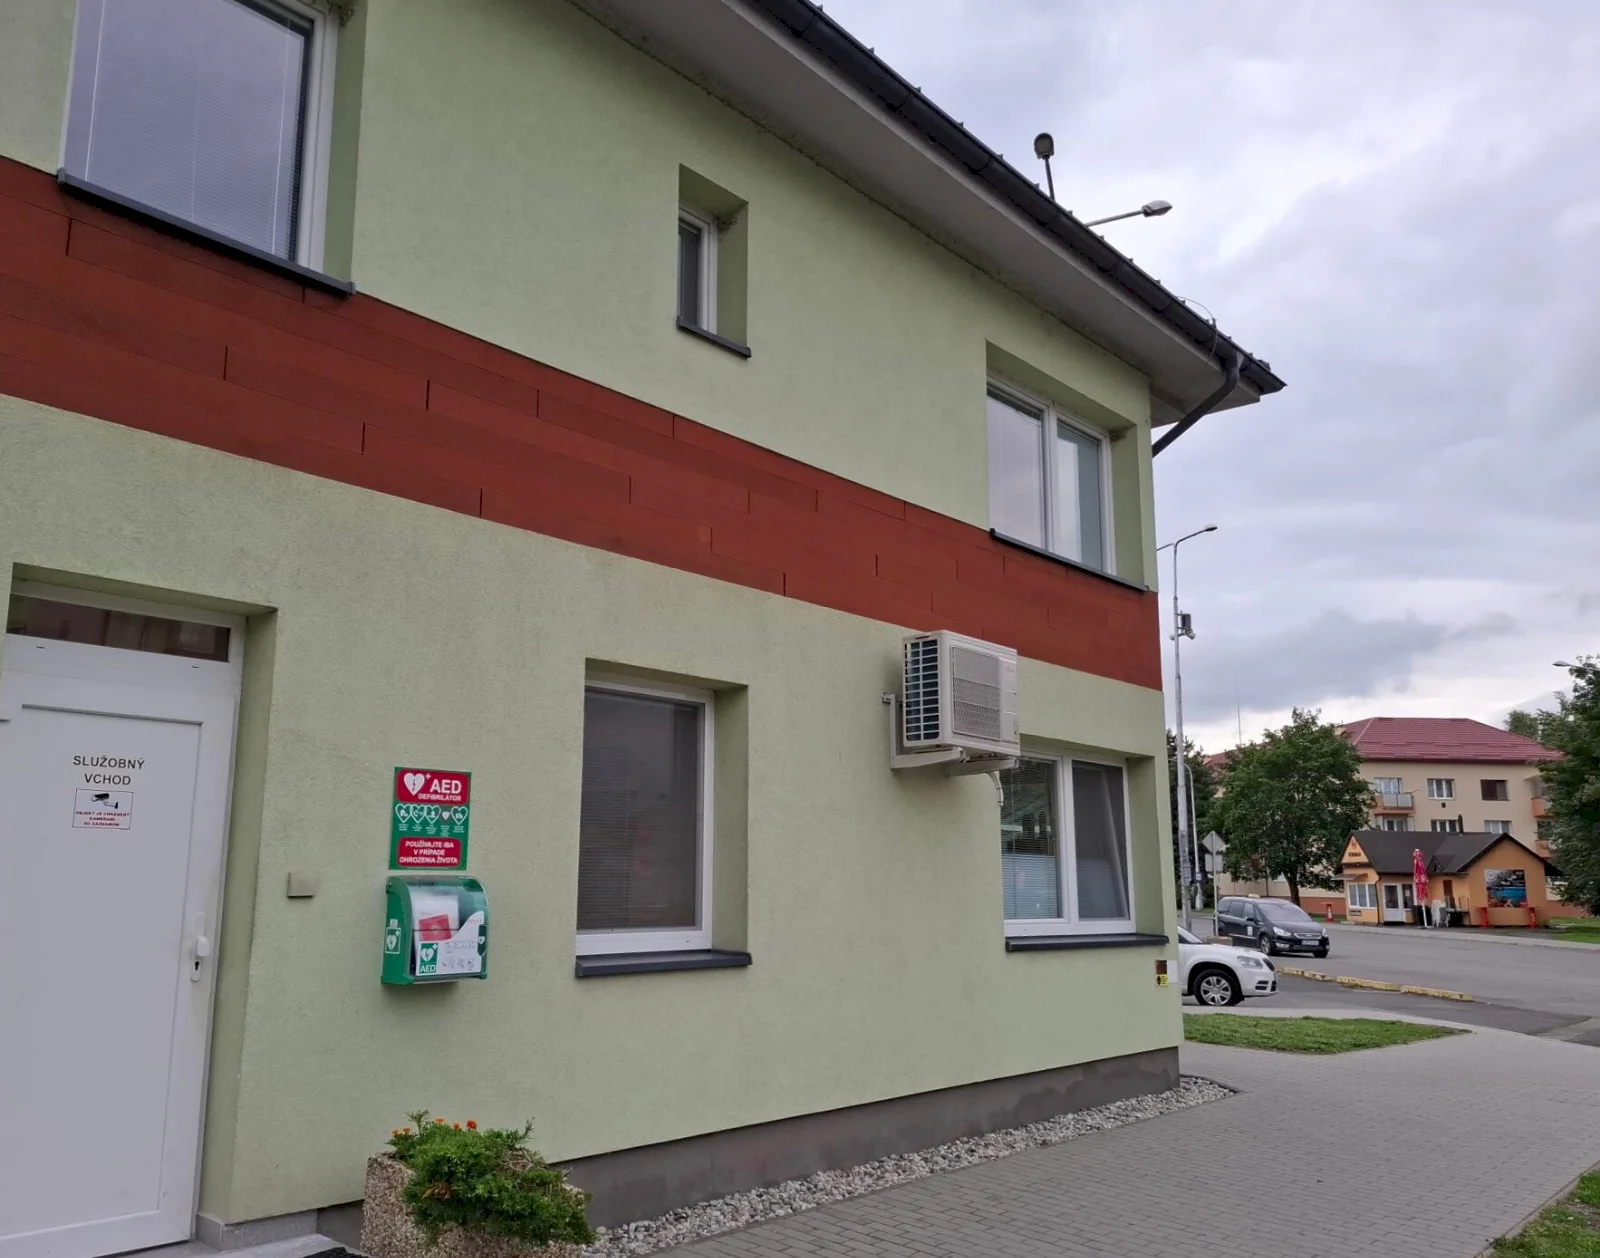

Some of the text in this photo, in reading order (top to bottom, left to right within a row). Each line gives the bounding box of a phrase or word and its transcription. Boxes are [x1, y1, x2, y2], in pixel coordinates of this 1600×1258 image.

[73, 755, 145, 769] SLUŽOBNÝ
[84, 773, 131, 785] VCHOD
[430, 779, 461, 794] AED
[405, 840, 442, 848] POUŽÍVAJTE
[419, 848, 445, 856] PRÍPADE
[399, 856, 458, 864] OHROZENIA ŽIVOTA
[420, 964, 436, 972] AED
